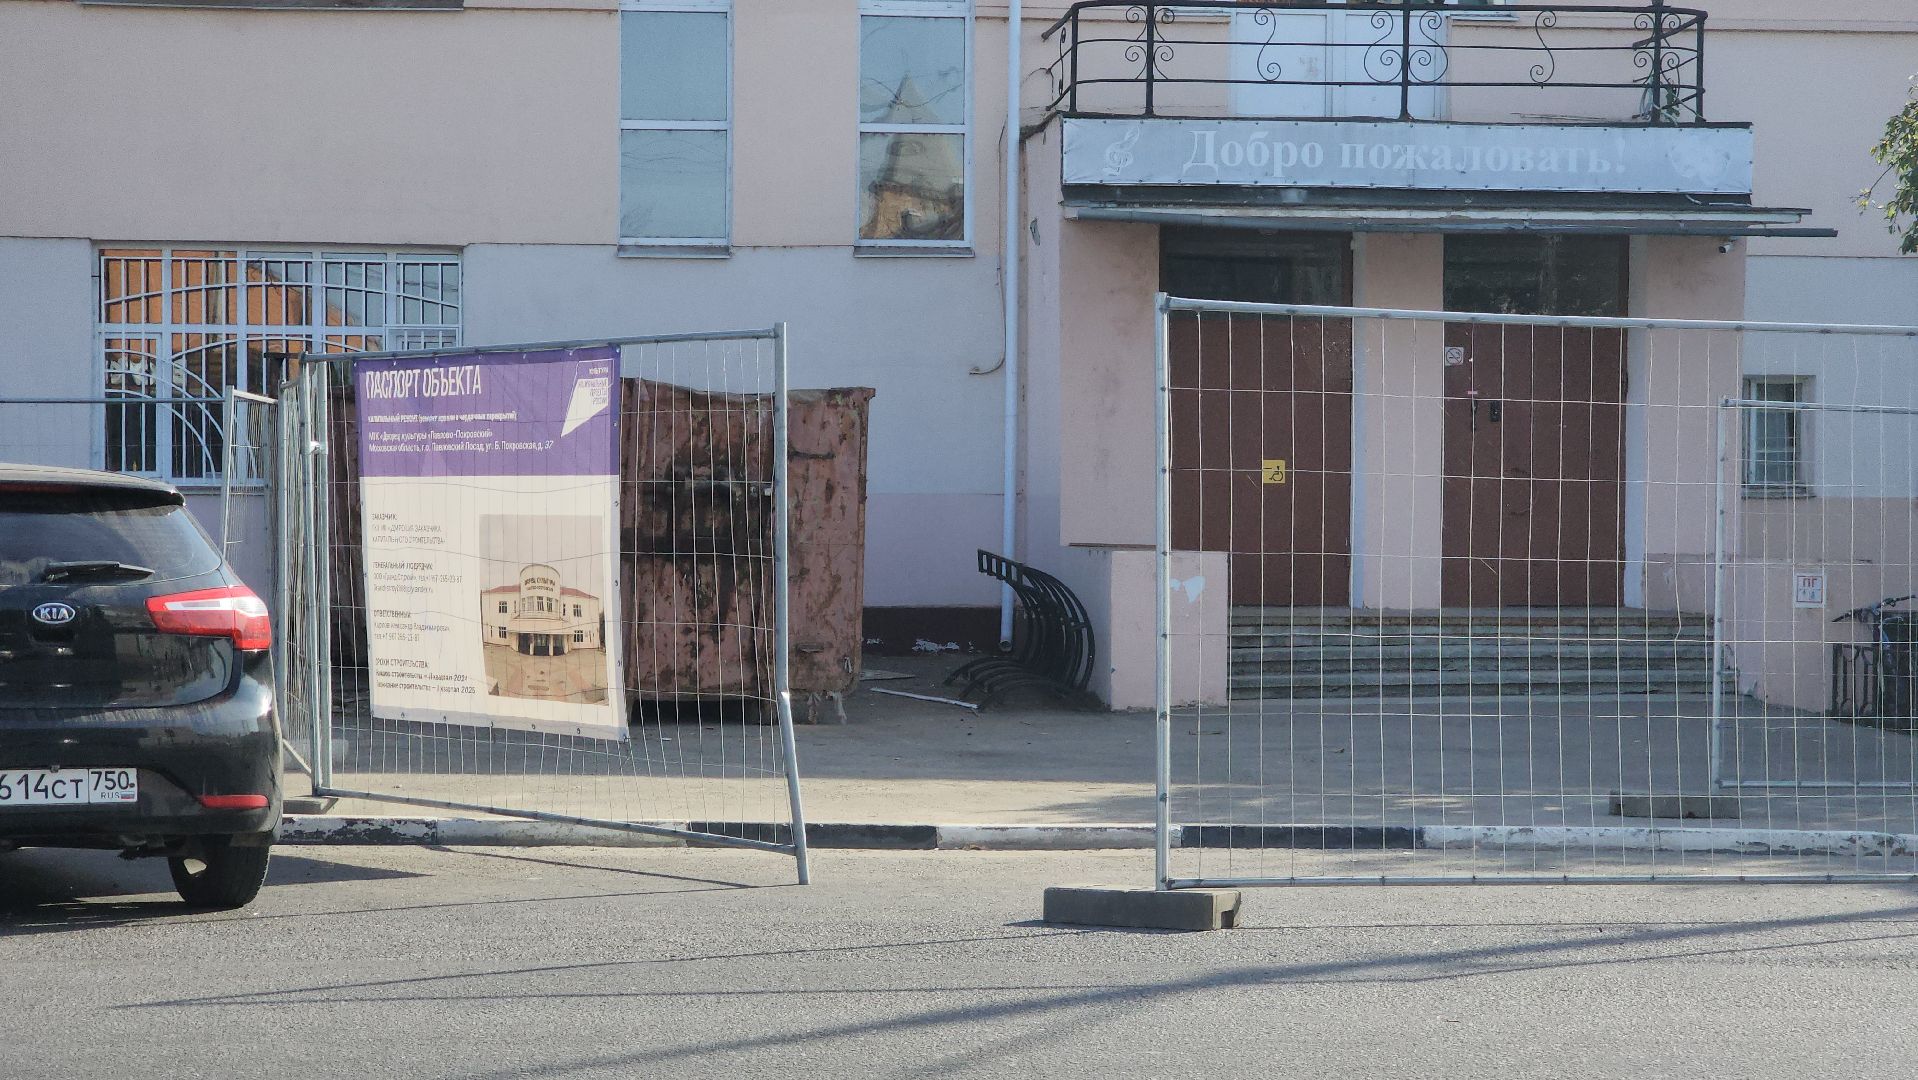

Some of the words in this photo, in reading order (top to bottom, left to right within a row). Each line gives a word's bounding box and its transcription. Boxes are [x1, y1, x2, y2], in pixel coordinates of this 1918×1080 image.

[1182, 130, 1324, 178] Добро
[1339, 137, 1626, 175] пожаловать!
[366, 368, 420, 399] ПАСПОРТ
[423, 365, 482, 397] ОБЪЕКТА
[544, 440, 554, 449] 37
[39, 606, 69, 621] KIA
[90, 769, 130, 791] 750
[100, 791, 120, 799] RUS
